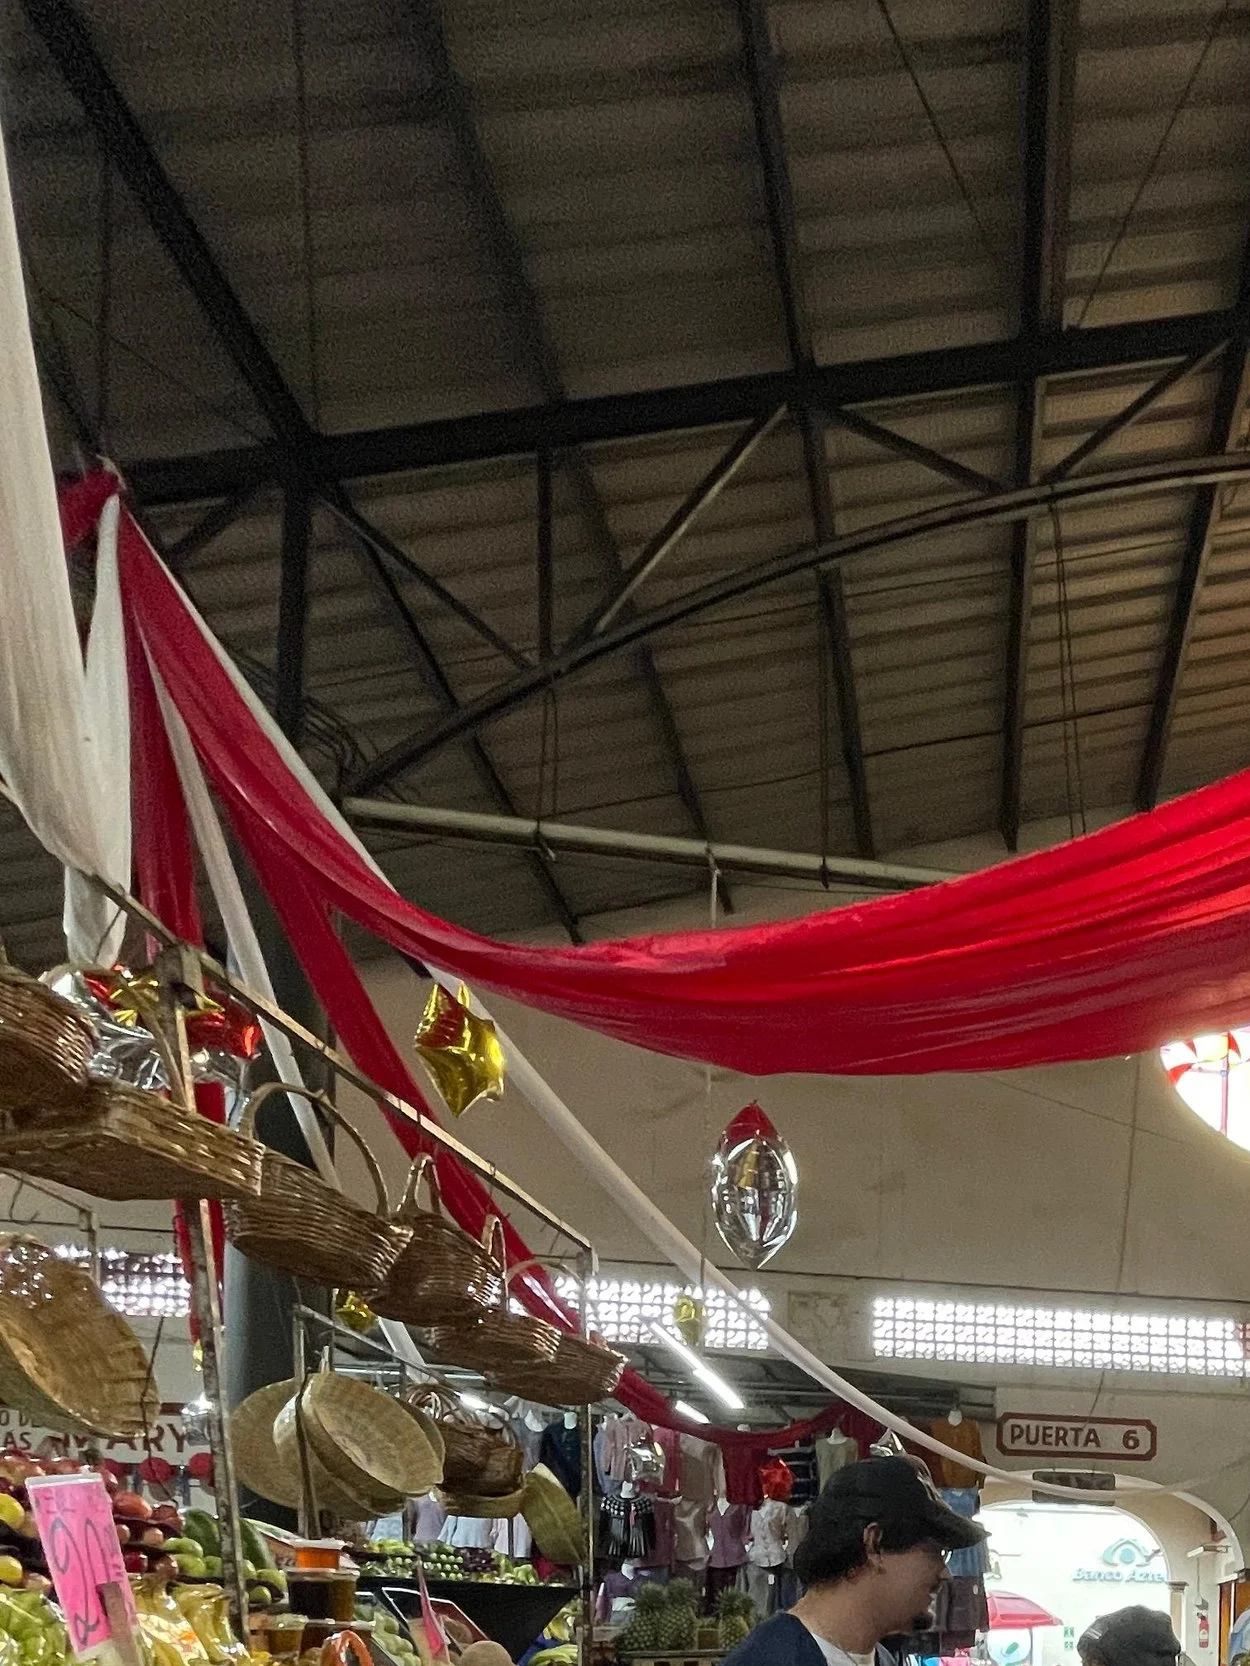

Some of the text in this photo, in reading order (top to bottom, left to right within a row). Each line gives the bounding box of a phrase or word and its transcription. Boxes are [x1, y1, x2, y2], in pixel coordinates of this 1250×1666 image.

[1010, 1424, 1140, 1450] PUERTA 6
[1072, 1568, 1123, 1582] Banco
